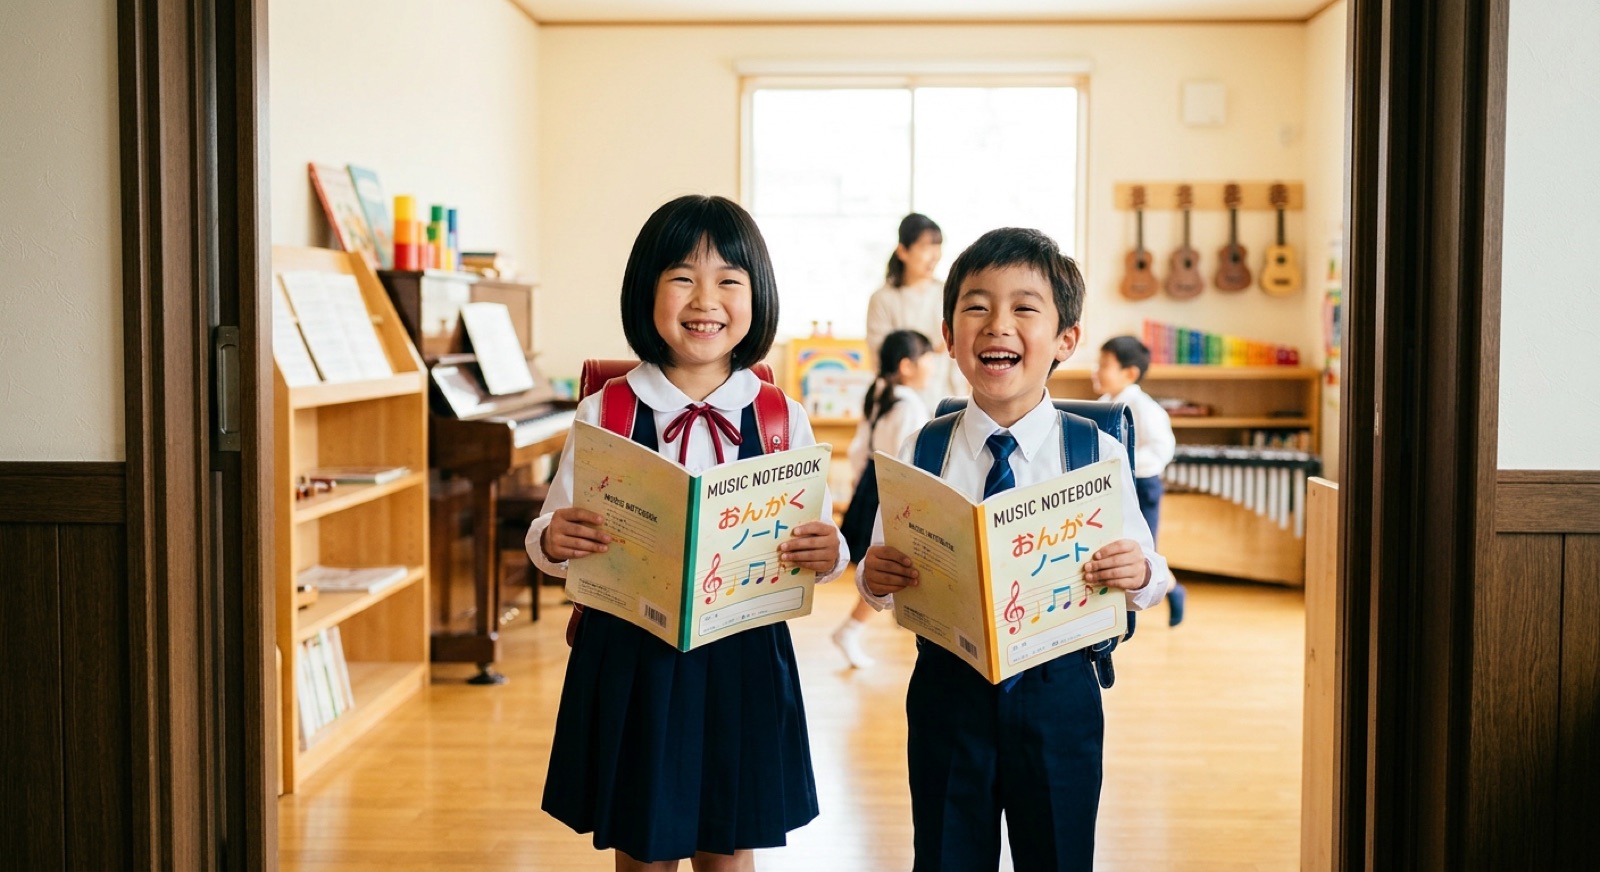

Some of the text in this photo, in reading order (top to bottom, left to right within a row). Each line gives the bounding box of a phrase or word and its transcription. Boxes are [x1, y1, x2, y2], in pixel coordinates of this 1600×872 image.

[707, 458, 822, 499] MUSIC NOTEBOOK
[718, 488, 805, 530] おんがく
[993, 500, 1036, 528] MUSIC
[1041, 474, 1112, 511] NOTEBOOK
[732, 520, 789, 550] ノート
[1011, 508, 1103, 558] おんがく
[1031, 542, 1090, 577] ノート
